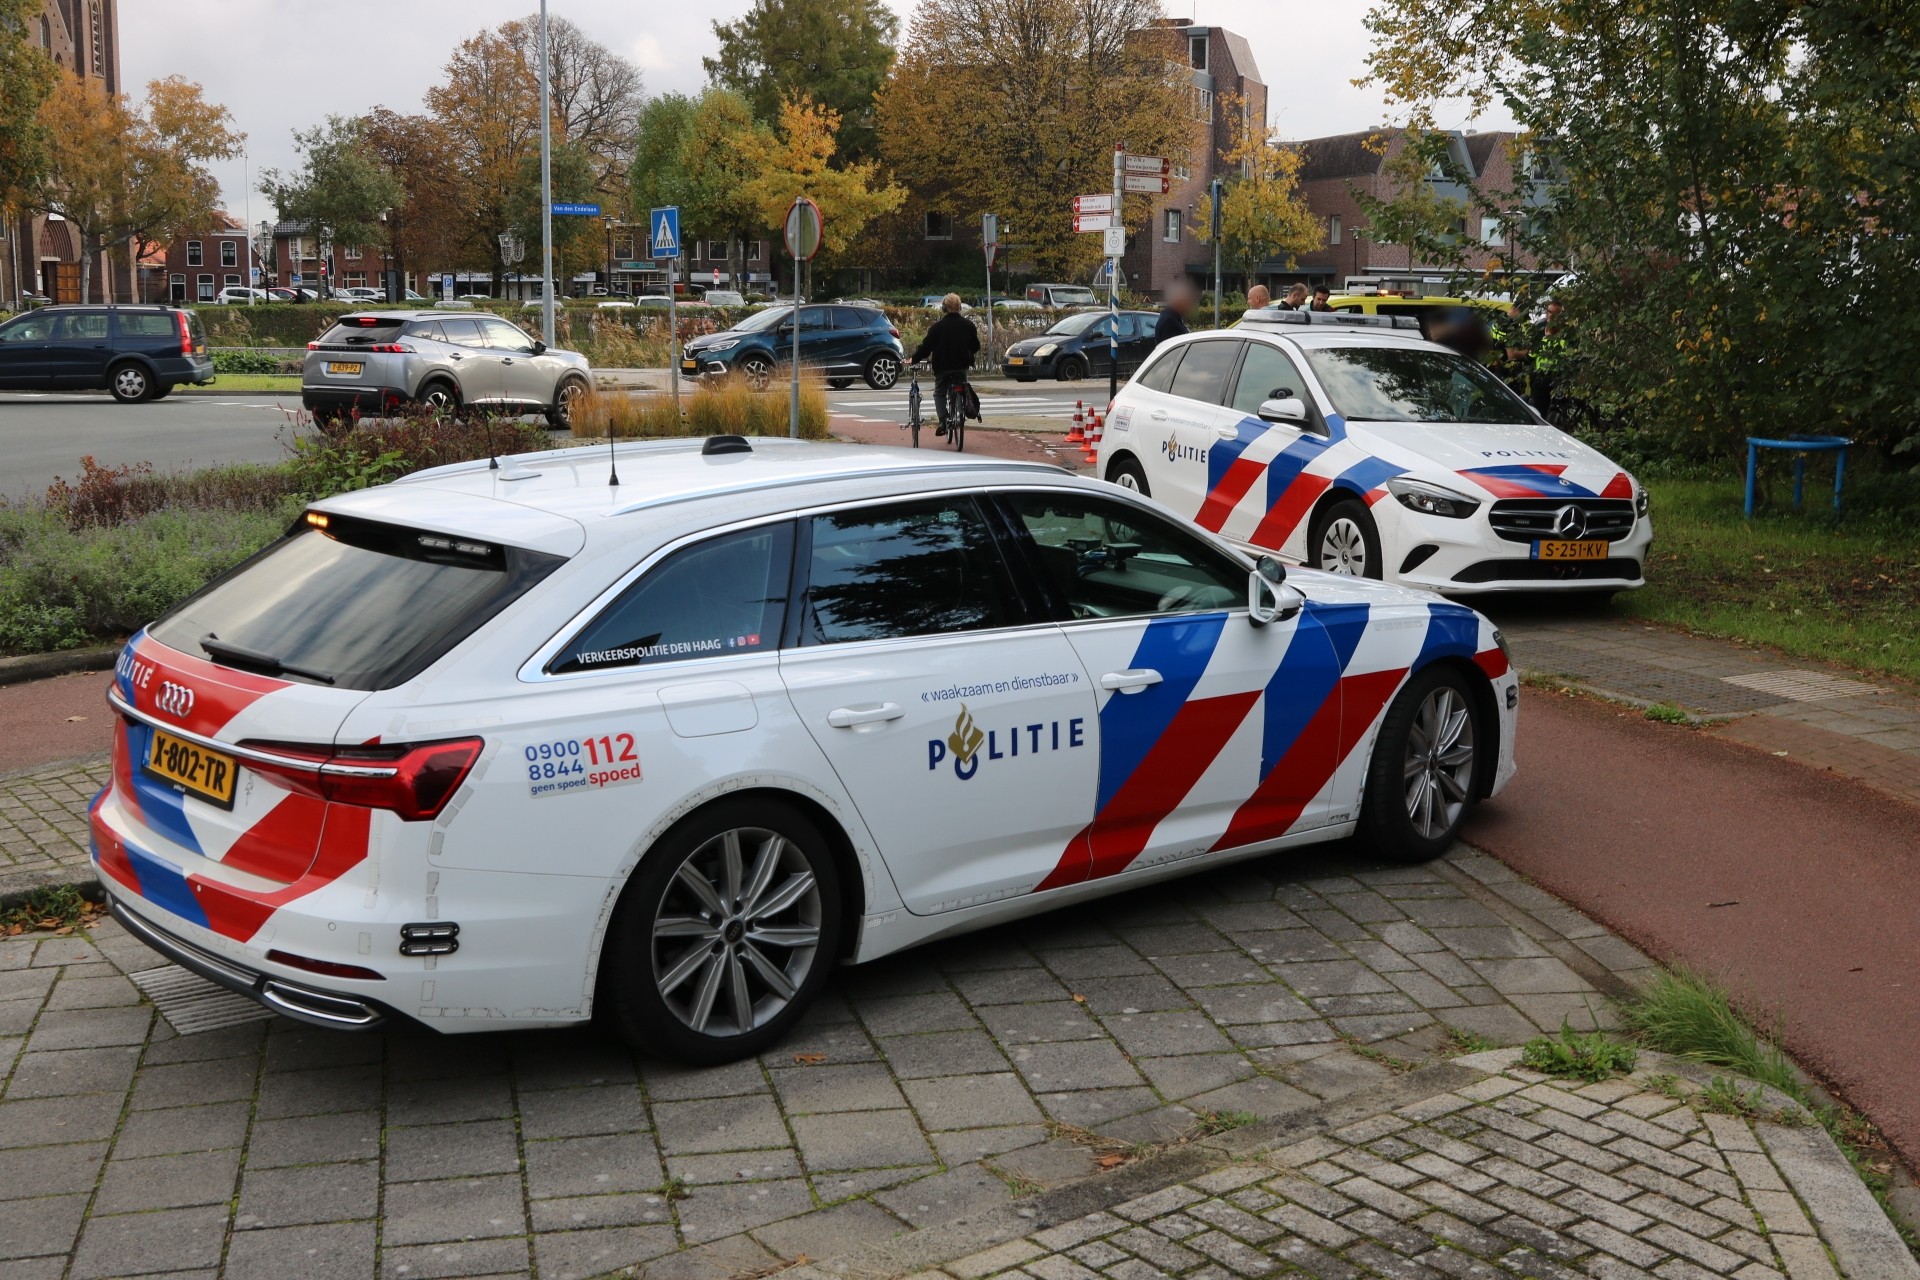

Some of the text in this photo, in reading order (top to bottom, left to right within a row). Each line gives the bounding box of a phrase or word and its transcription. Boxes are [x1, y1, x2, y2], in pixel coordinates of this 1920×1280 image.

[1162, 440, 1206, 463] POLITIE
[1481, 450, 1571, 459] POLITIE
[1546, 543, 1603, 558] S-251-KV
[576, 638, 722, 664] VERKEERSPOLITIE DEN HAAG
[930, 684, 993, 702] waakzaam
[995, 684, 1010, 694] en
[1011, 672, 1070, 692] dienstbaar
[525, 740, 580, 762] 0900
[583, 733, 638, 766] 112
[928, 717, 1084, 781] POLITIE
[153, 735, 227, 794] X-802-TR
[529, 759, 584, 781] 8844
[589, 763, 641, 788] spoed
[531, 778, 587, 796] geen spoed
